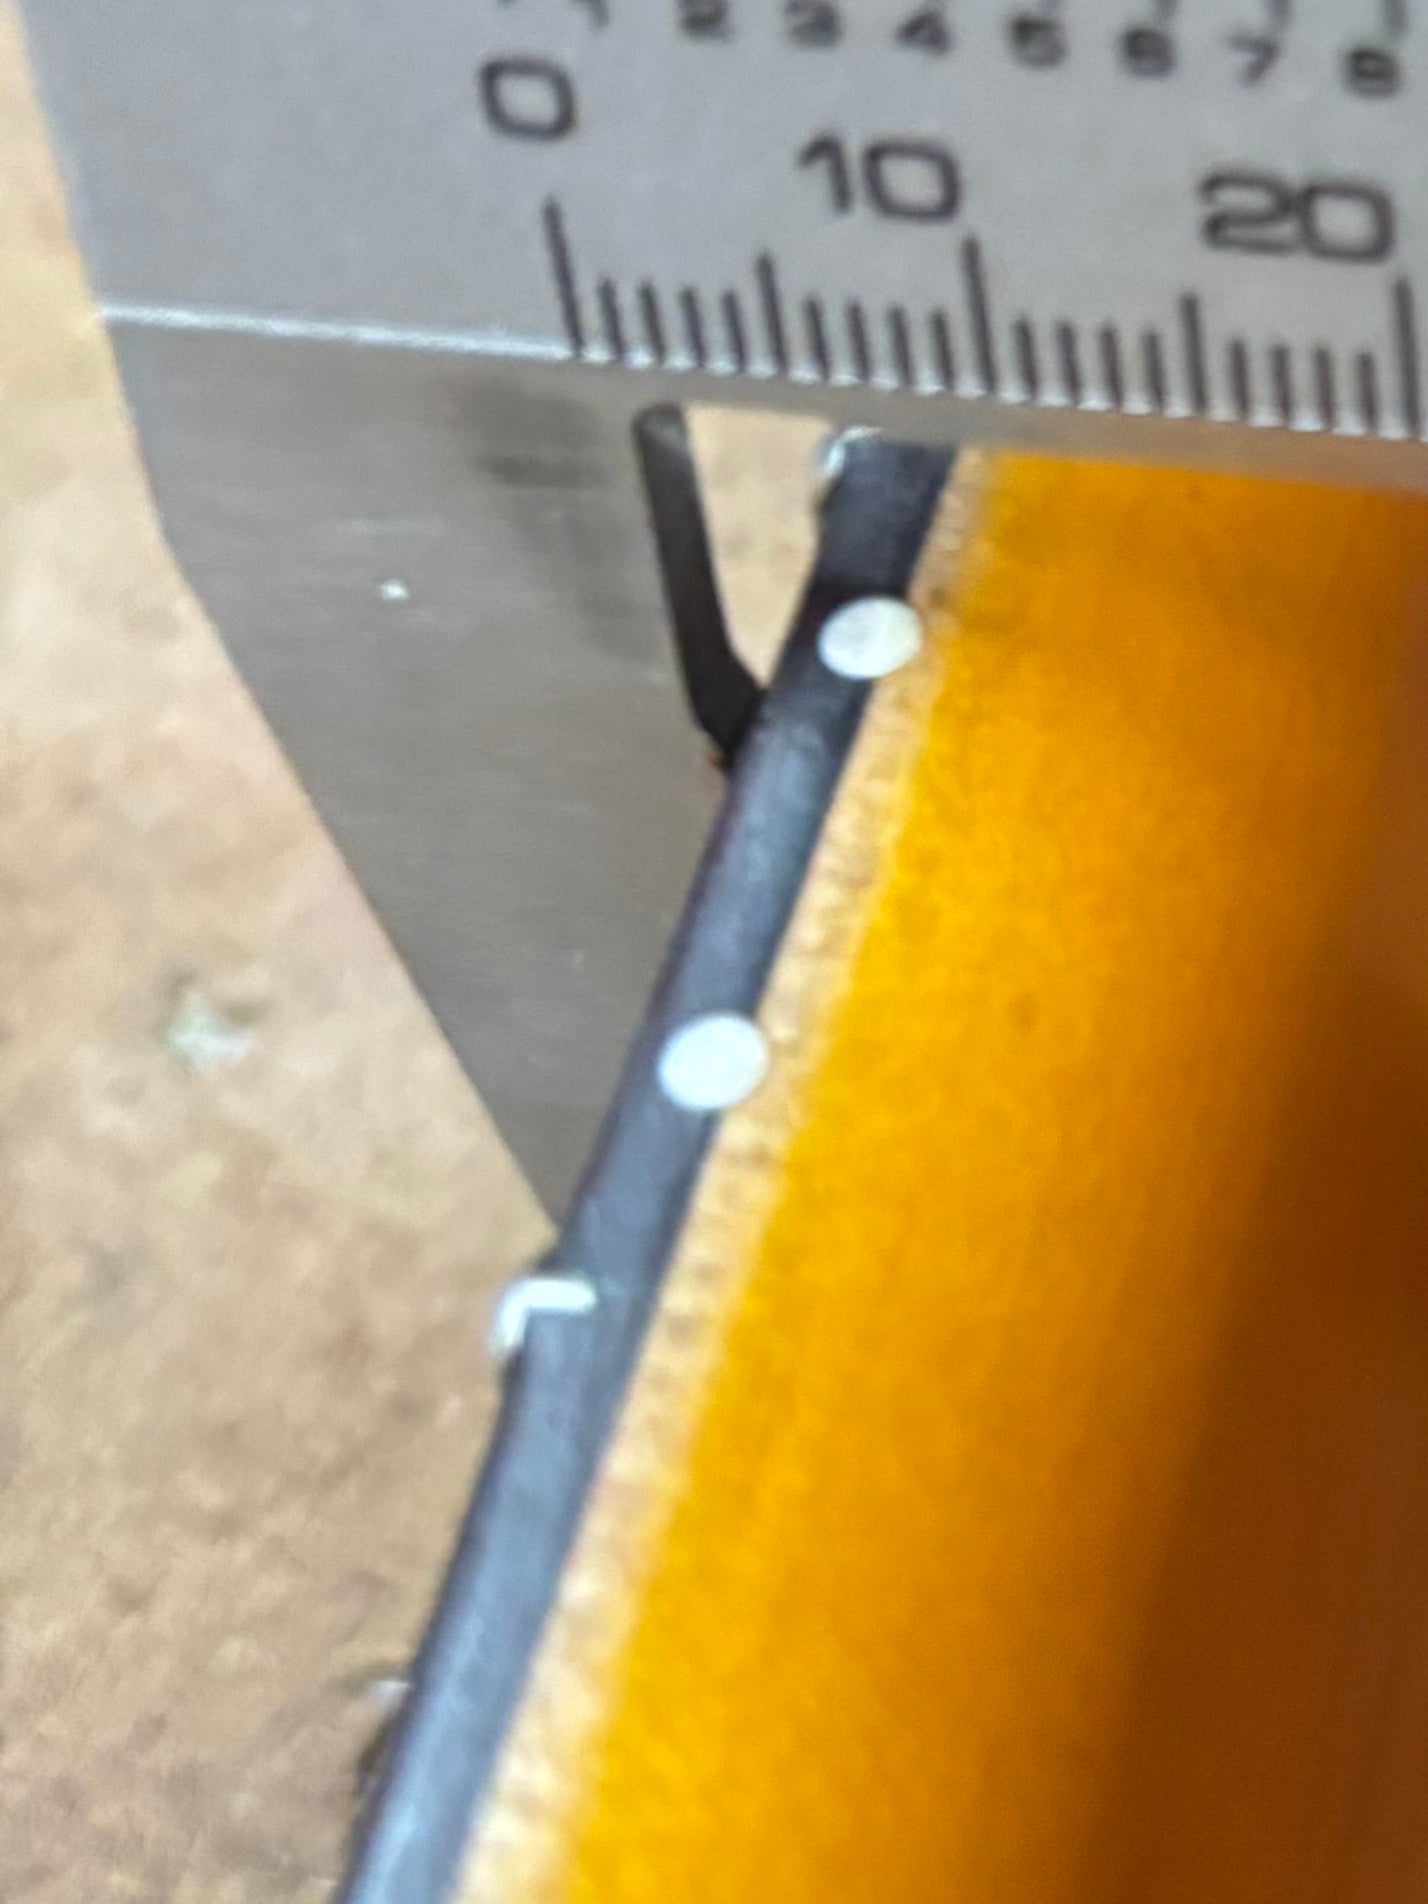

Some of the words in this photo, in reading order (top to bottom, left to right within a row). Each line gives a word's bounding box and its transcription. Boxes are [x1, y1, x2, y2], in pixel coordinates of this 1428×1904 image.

[478, 56, 576, 140] 0
[798, 132, 962, 224] 10
[1200, 168, 1396, 264] 20
